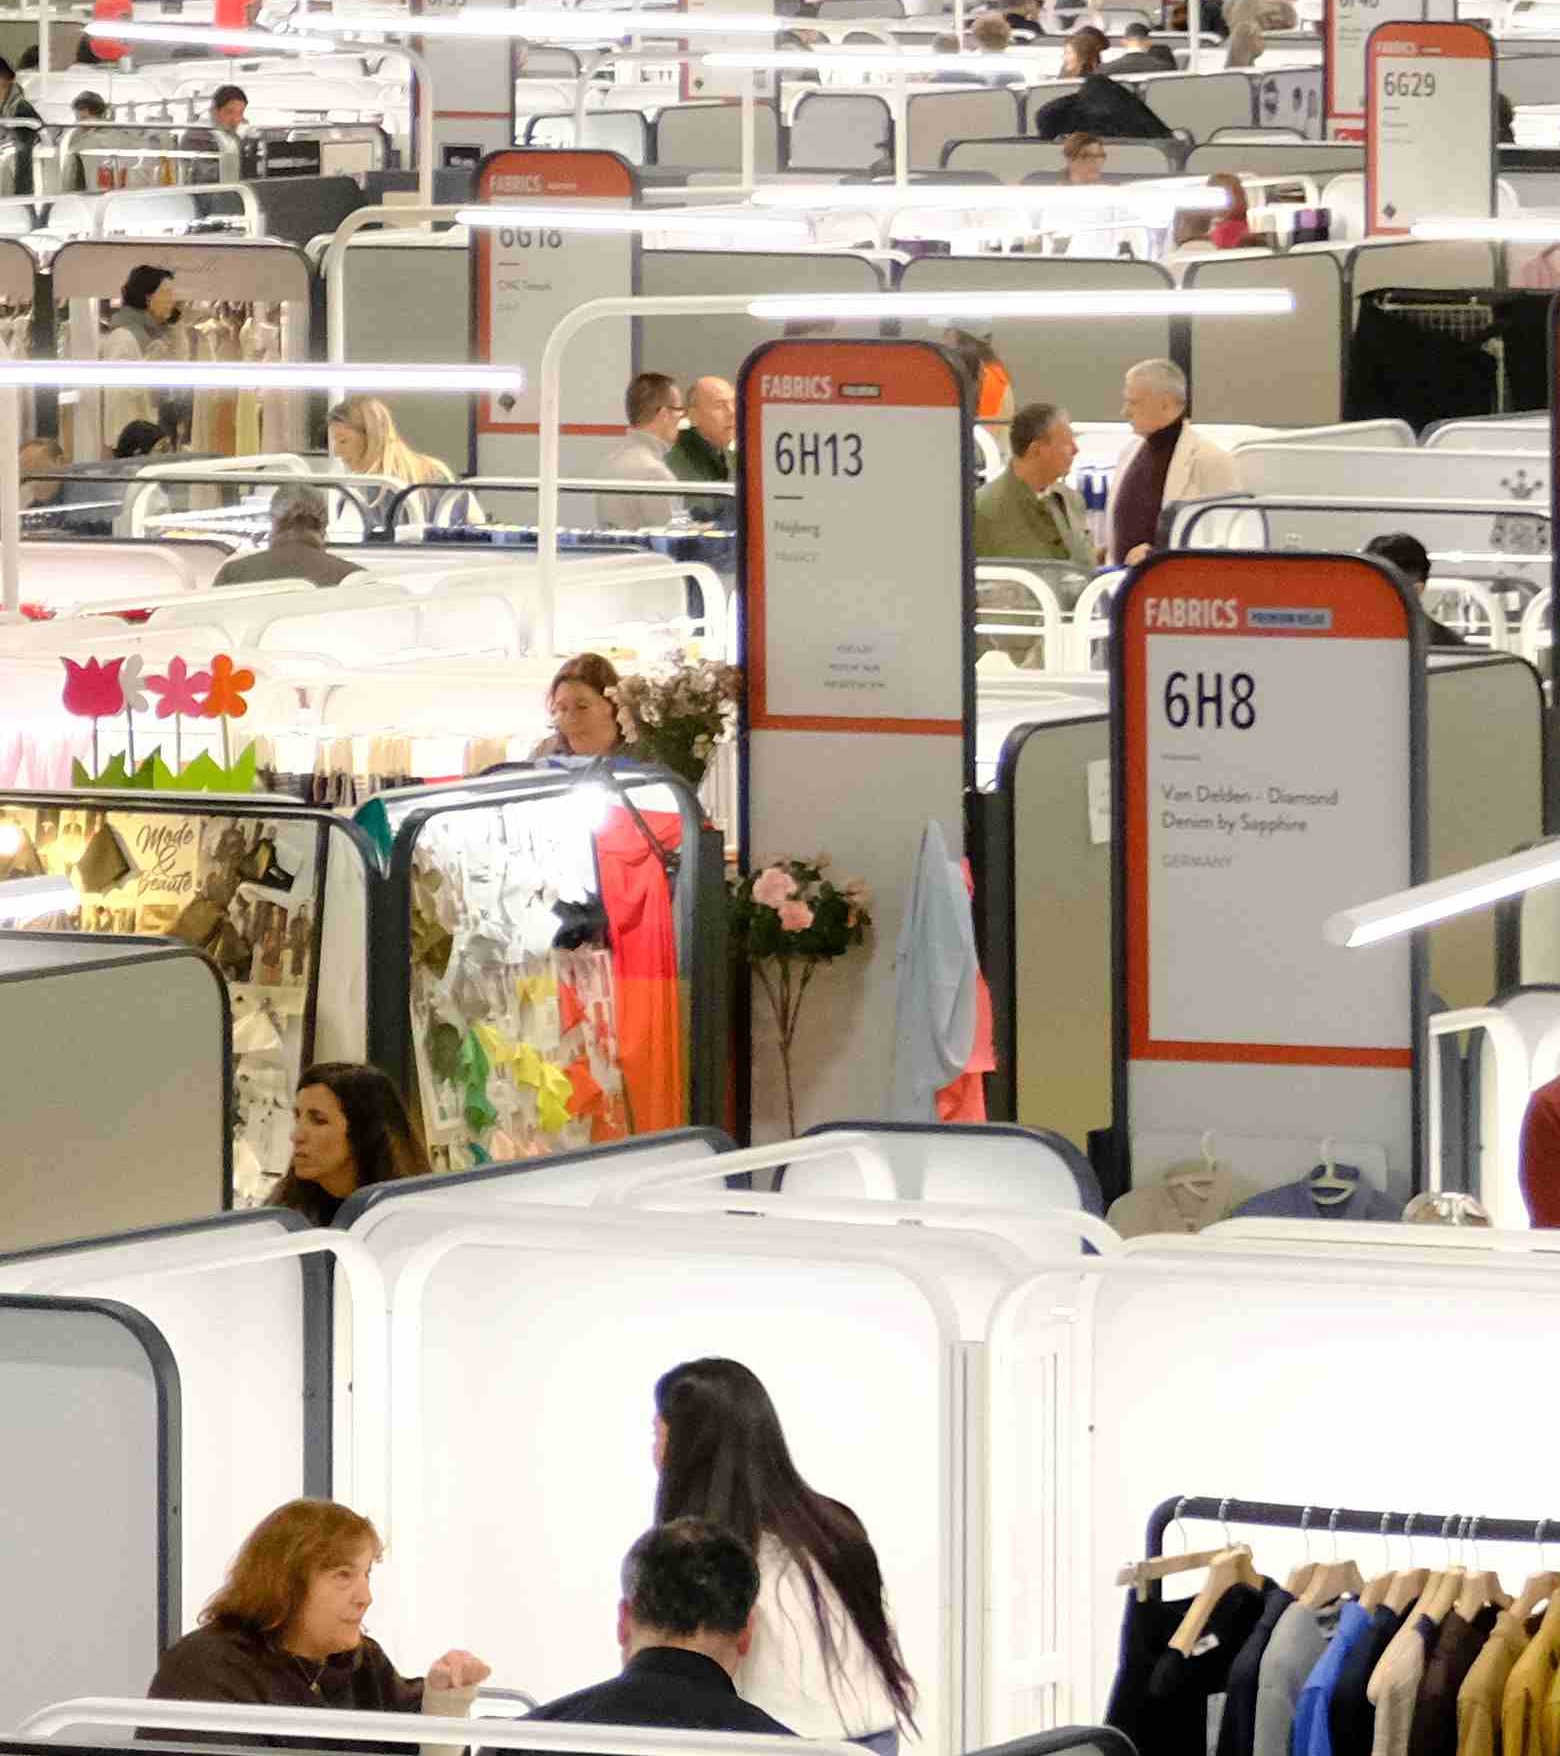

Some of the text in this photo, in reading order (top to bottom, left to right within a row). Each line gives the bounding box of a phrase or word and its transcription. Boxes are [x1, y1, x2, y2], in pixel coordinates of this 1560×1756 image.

[1384, 72, 1436, 98] 6G29
[488, 173, 544, 193] FABRICS
[760, 374, 833, 400] FABRICS
[774, 431, 864, 477] 6H13
[1144, 597, 1239, 630] FABRICS
[1162, 670, 1255, 730] 6H8
[1161, 786, 1193, 806] Van
[1199, 786, 1253, 807] Delden
[1268, 786, 1338, 808] Diamond
[135, 820, 194, 855] Mode
[1161, 812, 1308, 840] Denim by Sapphire
